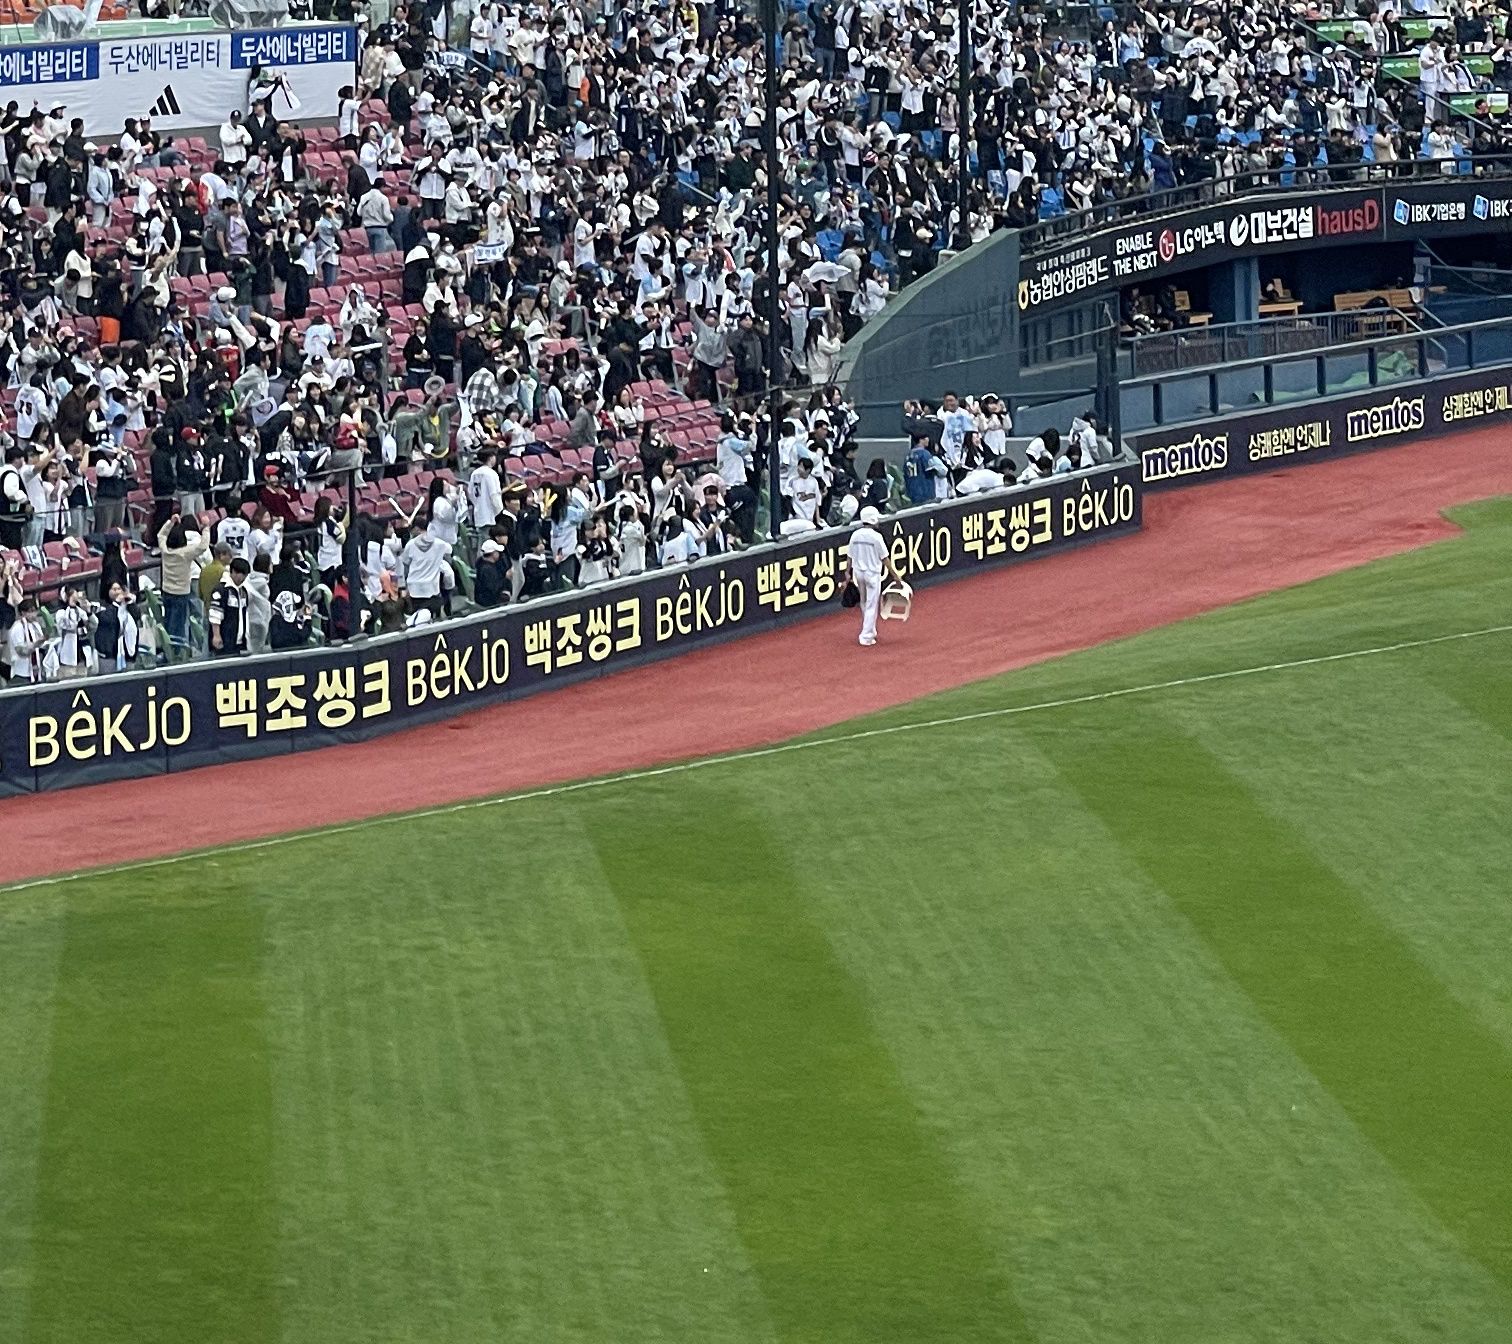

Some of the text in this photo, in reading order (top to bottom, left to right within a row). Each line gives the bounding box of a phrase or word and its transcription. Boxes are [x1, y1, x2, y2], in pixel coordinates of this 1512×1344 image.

[108, 38, 221, 75] 두산에너빌리티
[239, 30, 348, 65] 두산에너빌리티
[1250, 206, 1315, 244] 대보건설
[1316, 198, 1380, 235] hausD
[1411, 201, 1466, 223] IBK기업은행
[1490, 199, 1512, 218] IBK
[1116, 231, 1154, 255] ENABLE
[1112, 258, 1133, 277] THE
[1133, 250, 1158, 272] NEXT
[1296, 419, 1331, 452] 언제나
[1346, 397, 1424, 442] mentos
[1142, 433, 1228, 482] mentos
[214, 659, 393, 739] 백조씽크
[524, 596, 643, 675] 백조씽크
[961, 497, 1053, 561] 백조씽크
